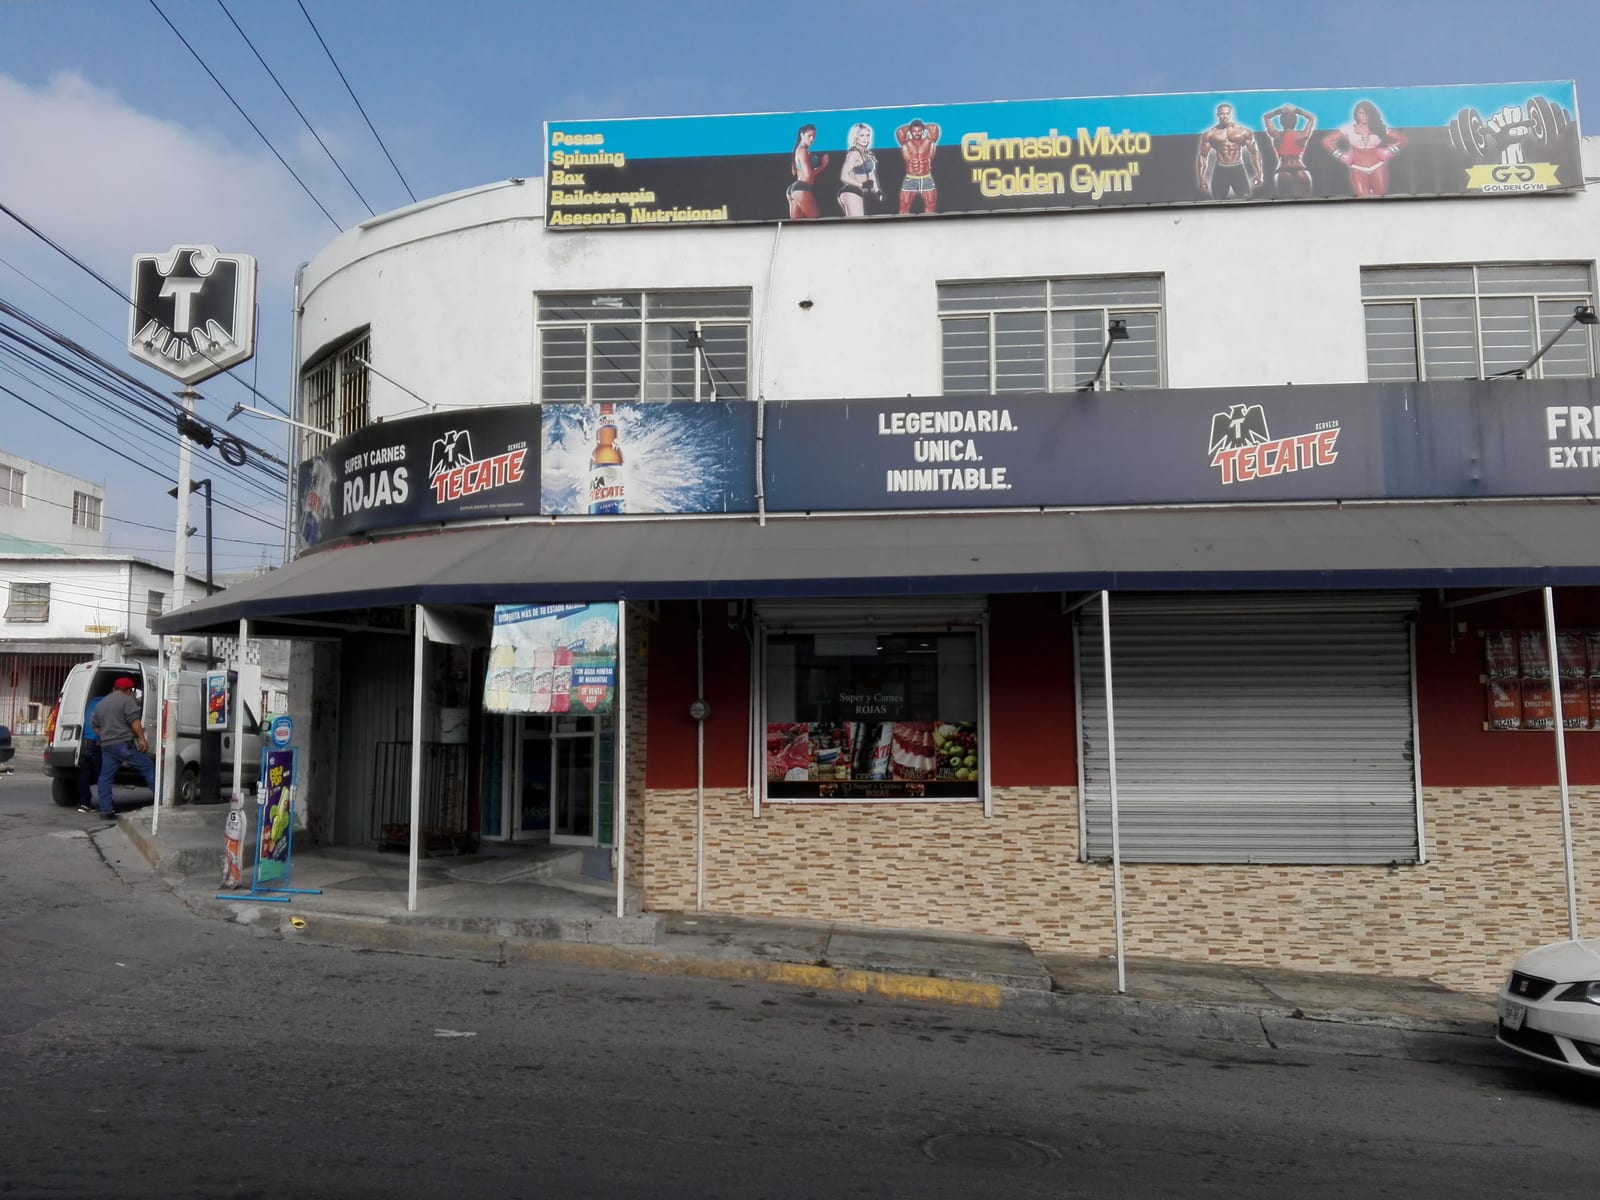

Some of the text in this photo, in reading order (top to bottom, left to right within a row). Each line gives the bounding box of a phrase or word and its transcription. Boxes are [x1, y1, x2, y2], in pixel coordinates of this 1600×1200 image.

[552, 131, 604, 146] Pesas
[961, 126, 1151, 161] Gimnasio Mixto
[552, 150, 625, 168] Spinning
[551, 170, 585, 185] Box
[550, 188, 655, 206] Bailoterapia
[631, 205, 728, 223] Nutricional
[878, 409, 1018, 435] LEGENDARIA.
[914, 437, 983, 463] ÚNICA.
[1210, 427, 1341, 485] TECATE
[344, 444, 406, 475] SUPER Y CARNES
[430, 447, 528, 505] TECATE
[886, 467, 1012, 493] INIMITABLE.
[343, 467, 408, 517] ROJAS
[590, 485, 624, 501] TECATE
[532, 607, 539, 617] DE
[839, 692, 904, 705] Super y Carnes
[855, 705, 887, 715] ROJAS
